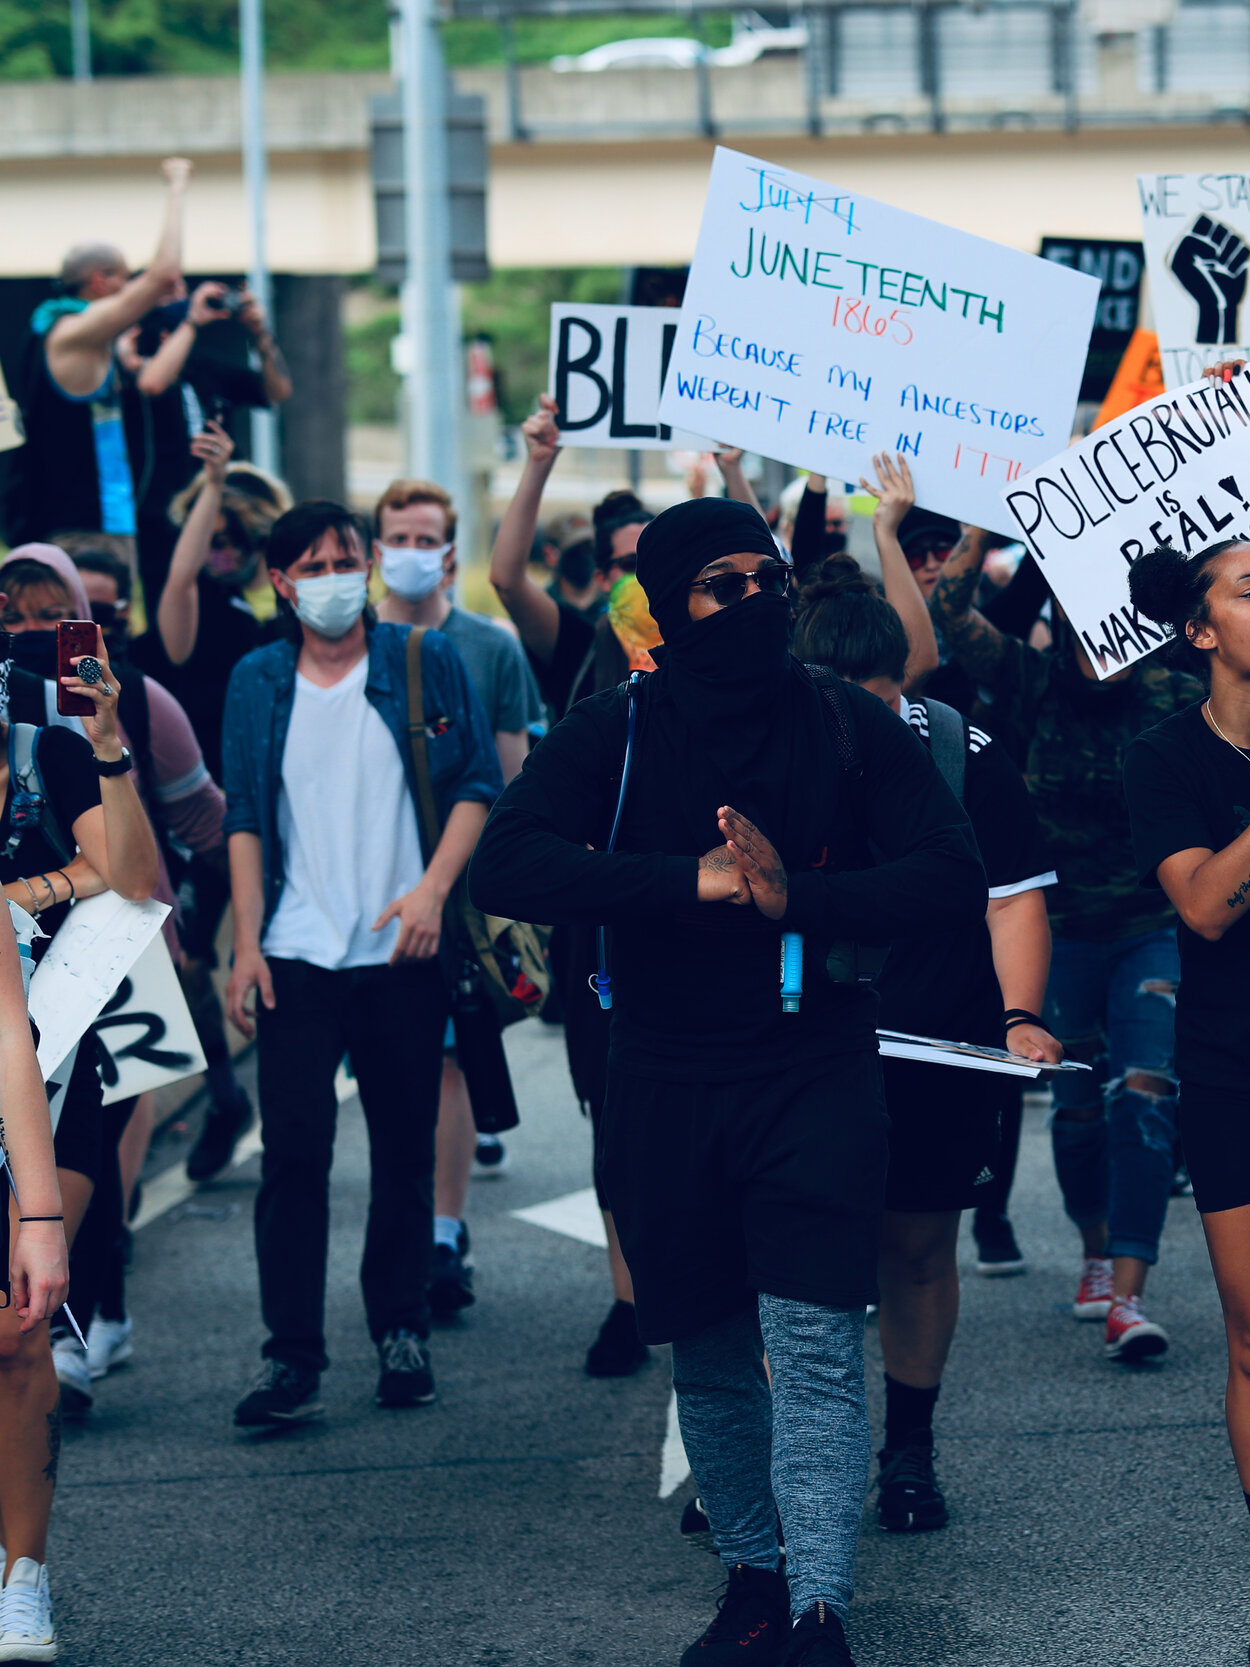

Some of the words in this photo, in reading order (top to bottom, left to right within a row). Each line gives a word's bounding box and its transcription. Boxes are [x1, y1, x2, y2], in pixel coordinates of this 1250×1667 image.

[1136, 175, 1187, 218] WE
[730, 227, 1005, 334] JUNETEENTH
[832, 295, 914, 346] 1865
[691, 313, 805, 378] BECAUSE
[900, 383, 1045, 438] ANCESTORS
[676, 371, 792, 423] WEREN'T
[808, 409, 870, 444] FREE
[896, 431, 922, 457] IN
[1155, 489, 1182, 518] IS
[1081, 604, 1168, 673] WAK
